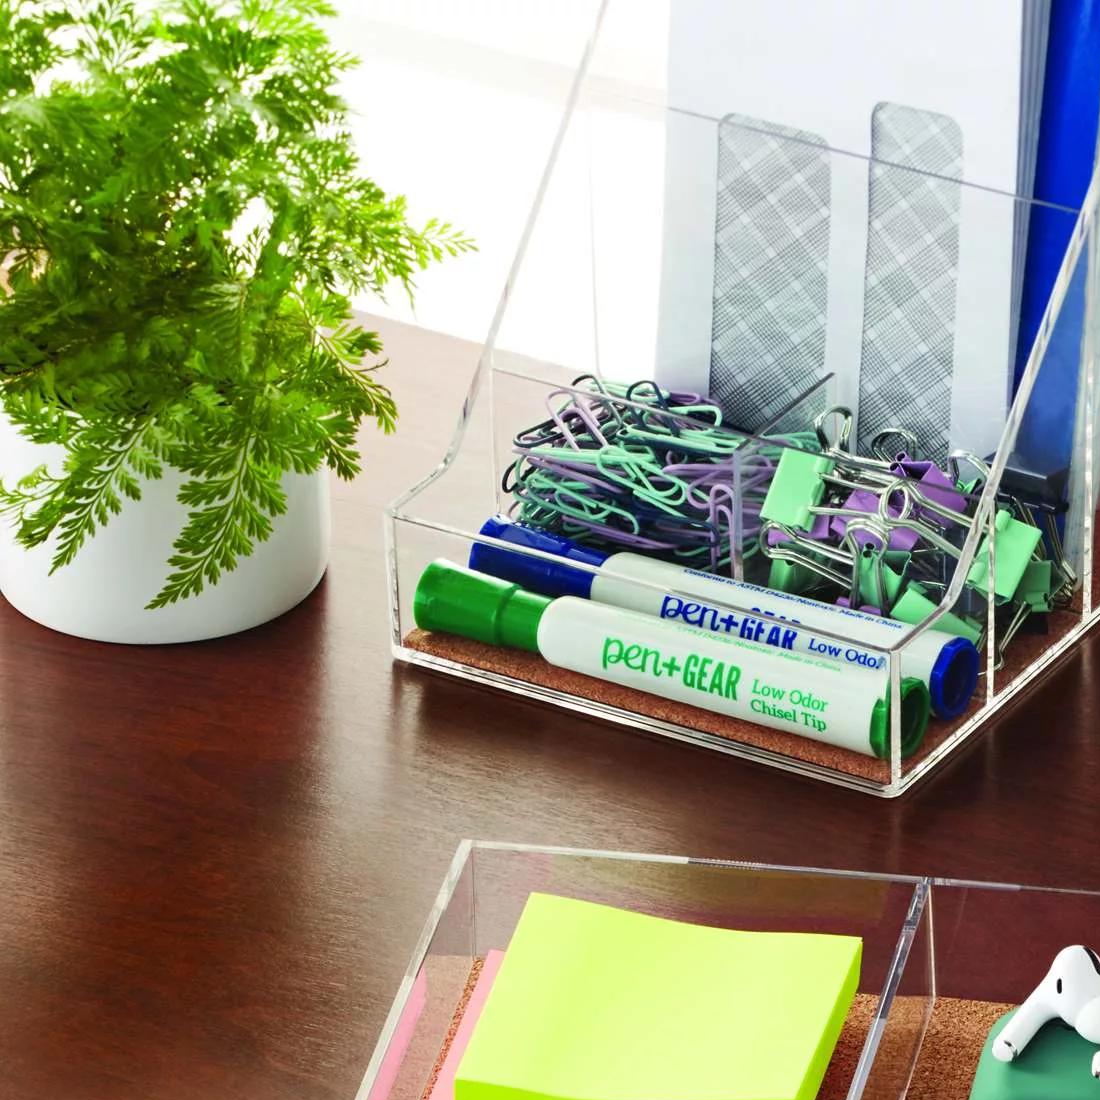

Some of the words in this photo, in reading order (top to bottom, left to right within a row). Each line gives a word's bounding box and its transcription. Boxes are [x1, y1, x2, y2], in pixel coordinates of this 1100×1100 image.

[808, 638, 842, 658] Low
[602, 637, 742, 701] pen+GEAR
[752, 679, 786, 701] Low
[789, 689, 829, 713] Odor
[751, 699, 797, 724] Chisel
[801, 711, 827, 733] Tip
